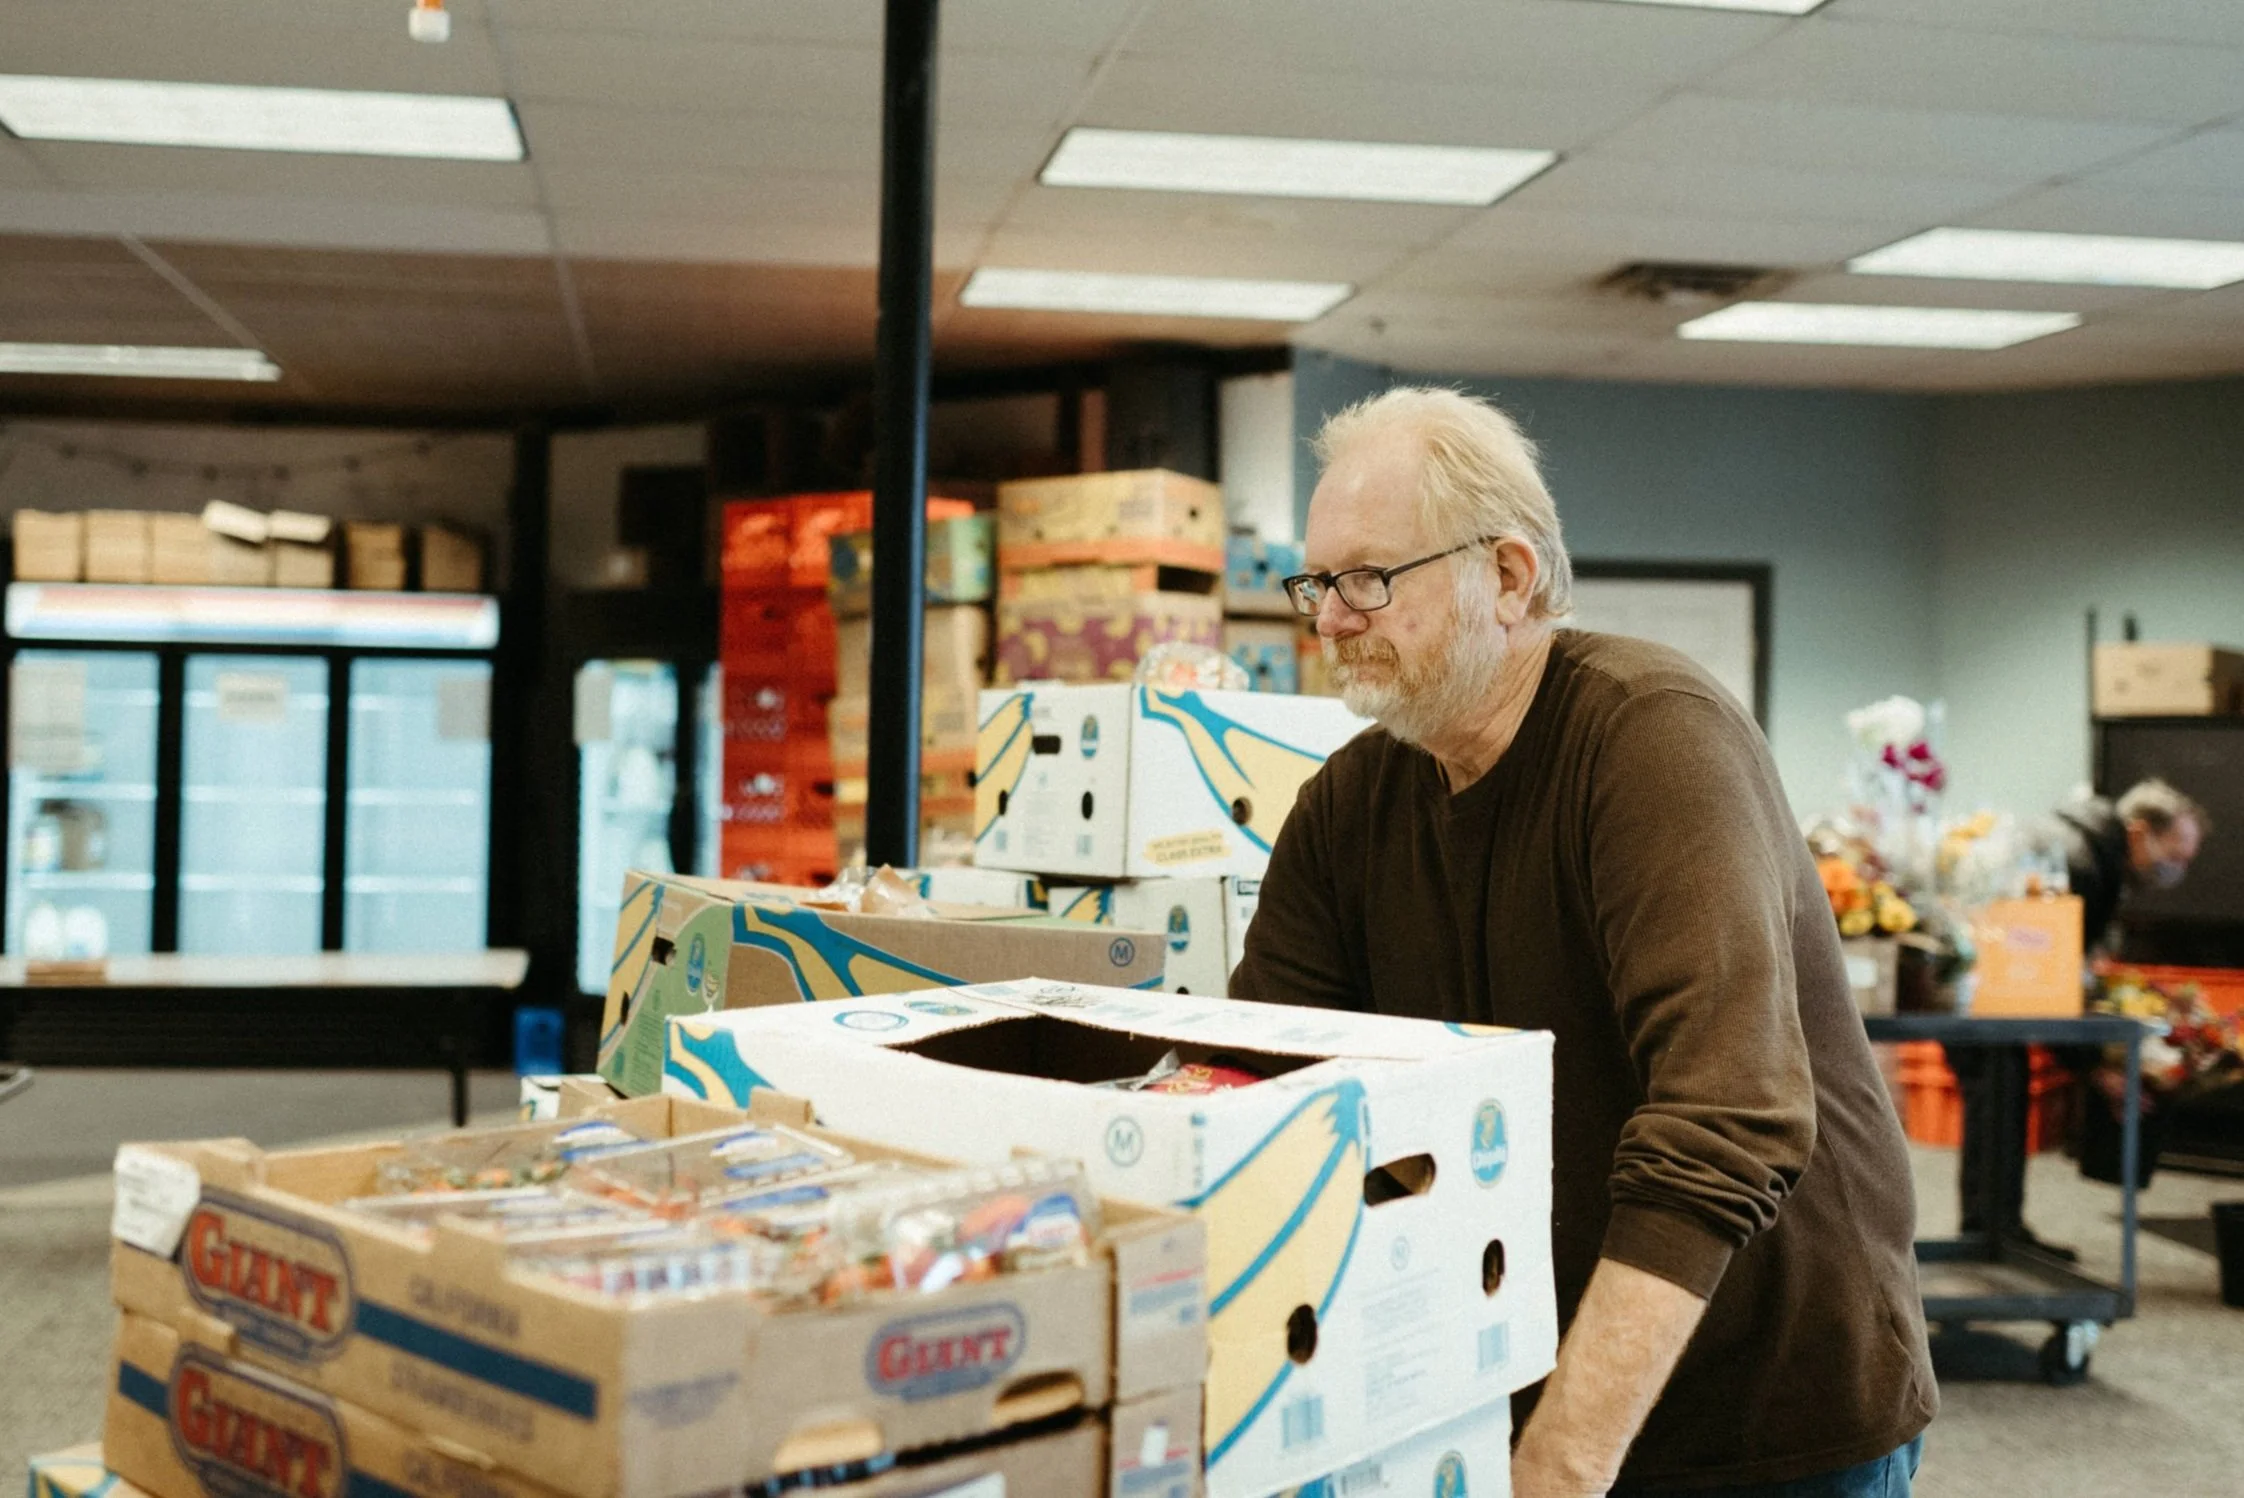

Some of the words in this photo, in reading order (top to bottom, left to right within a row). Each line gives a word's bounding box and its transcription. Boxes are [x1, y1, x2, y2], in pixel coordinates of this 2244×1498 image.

[188, 1209, 337, 1334] GIANT
[877, 1325, 1012, 1382] GIANT
[177, 1366, 333, 1498] GIANT
